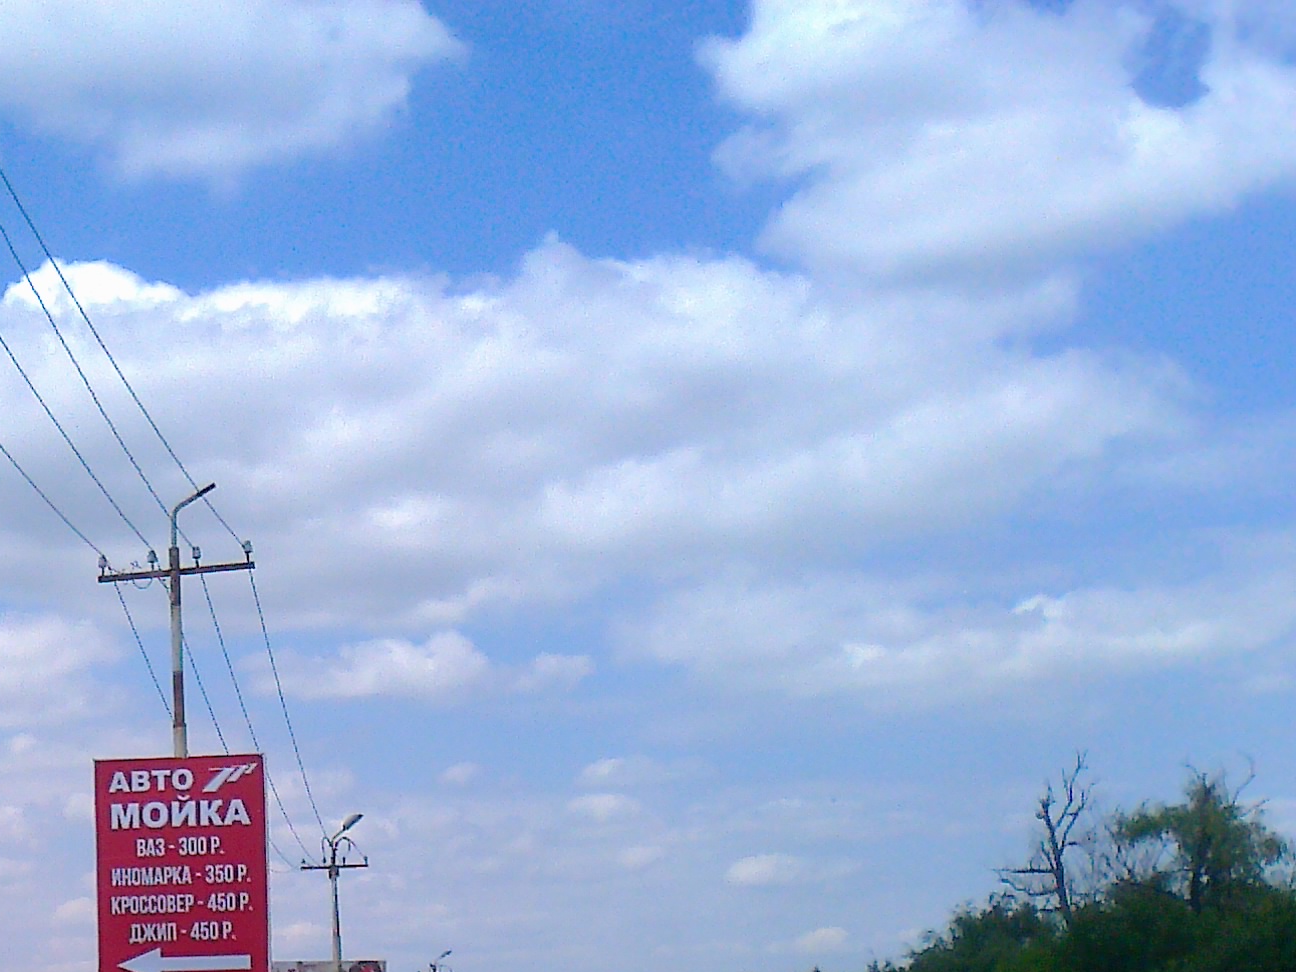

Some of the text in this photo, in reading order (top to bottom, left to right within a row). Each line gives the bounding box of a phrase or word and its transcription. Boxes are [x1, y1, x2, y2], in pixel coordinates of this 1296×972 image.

[108, 769, 194, 793] АВТО
[110, 794, 252, 830] МОЙКА
[136, 838, 166, 857] ВАЗ
[178, 837, 208, 855] 300
[111, 865, 192, 886] ИНОМАРКА
[205, 864, 234, 883] 350
[110, 894, 195, 915] КРОССОВЕР
[207, 893, 237, 911] 450
[129, 922, 178, 944] ДЖИП
[190, 921, 220, 940] 450
